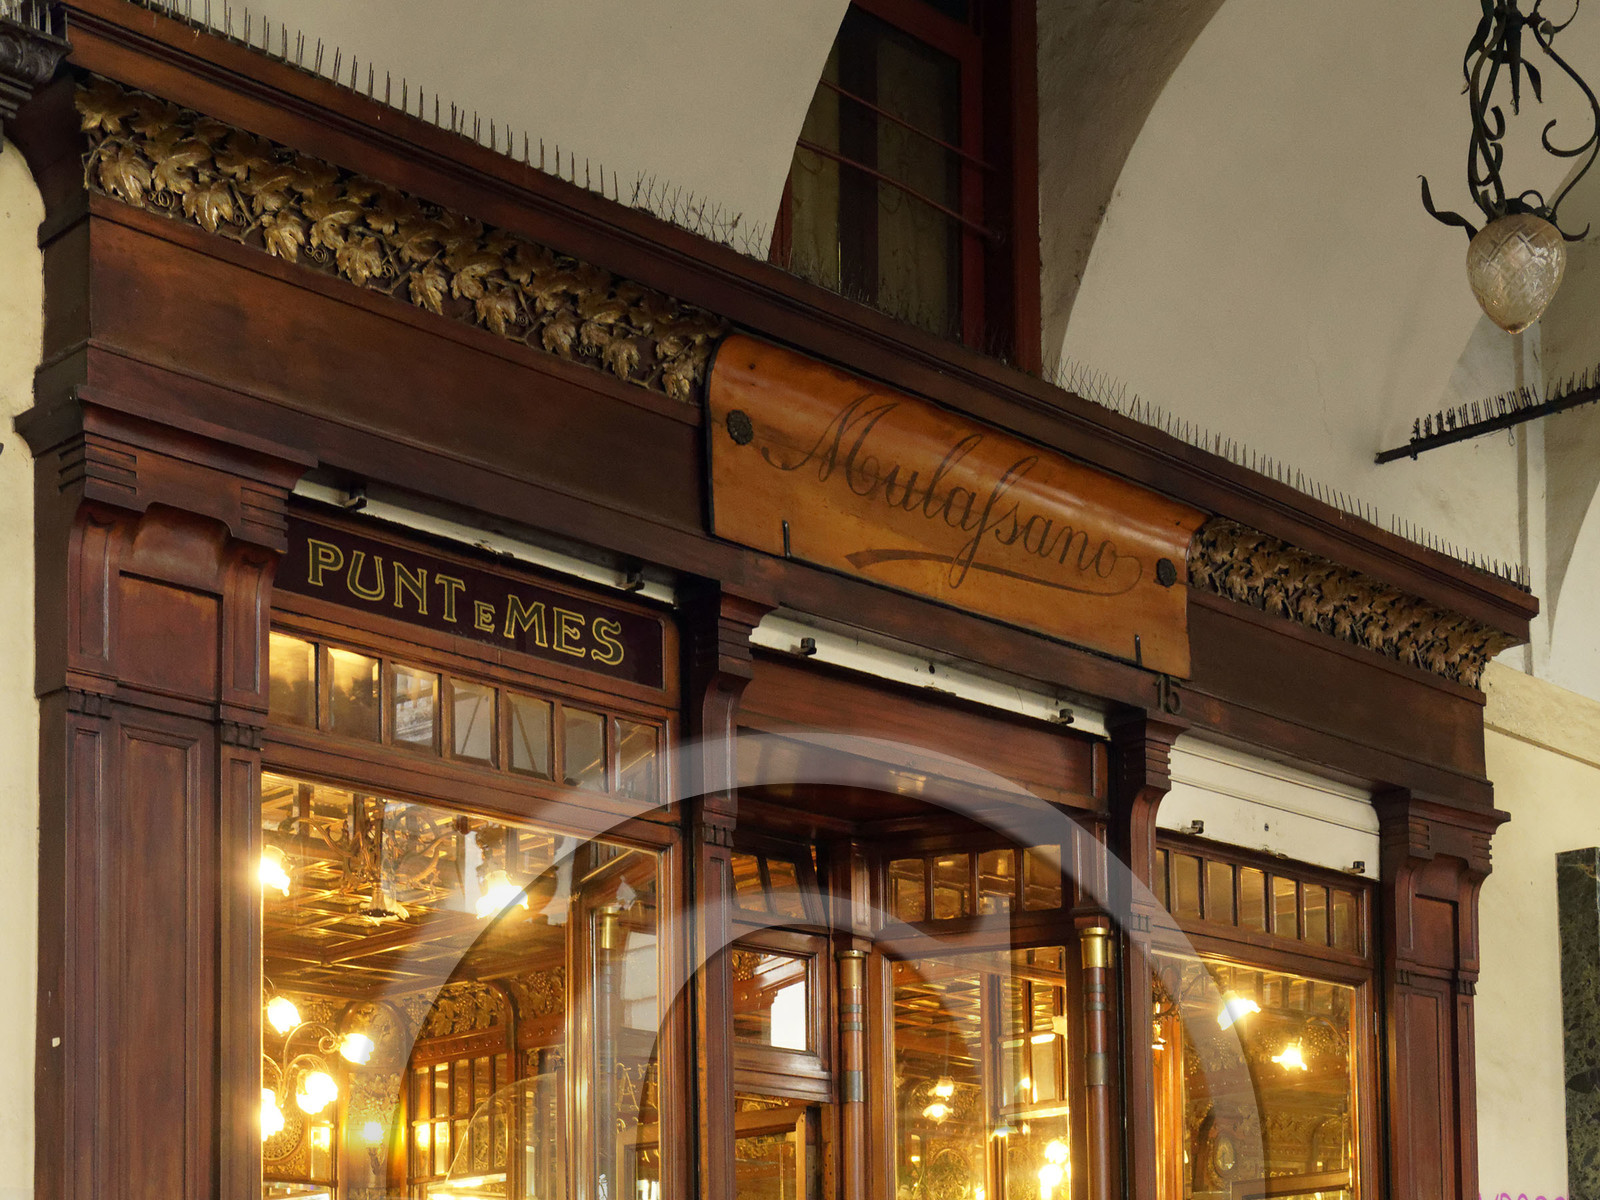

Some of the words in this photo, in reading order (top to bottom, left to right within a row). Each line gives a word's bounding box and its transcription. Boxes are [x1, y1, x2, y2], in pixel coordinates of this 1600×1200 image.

[307, 538, 466, 623] PUNT
[474, 600, 496, 632] E
[503, 594, 625, 666] MES
[1153, 674, 1182, 715] 15
